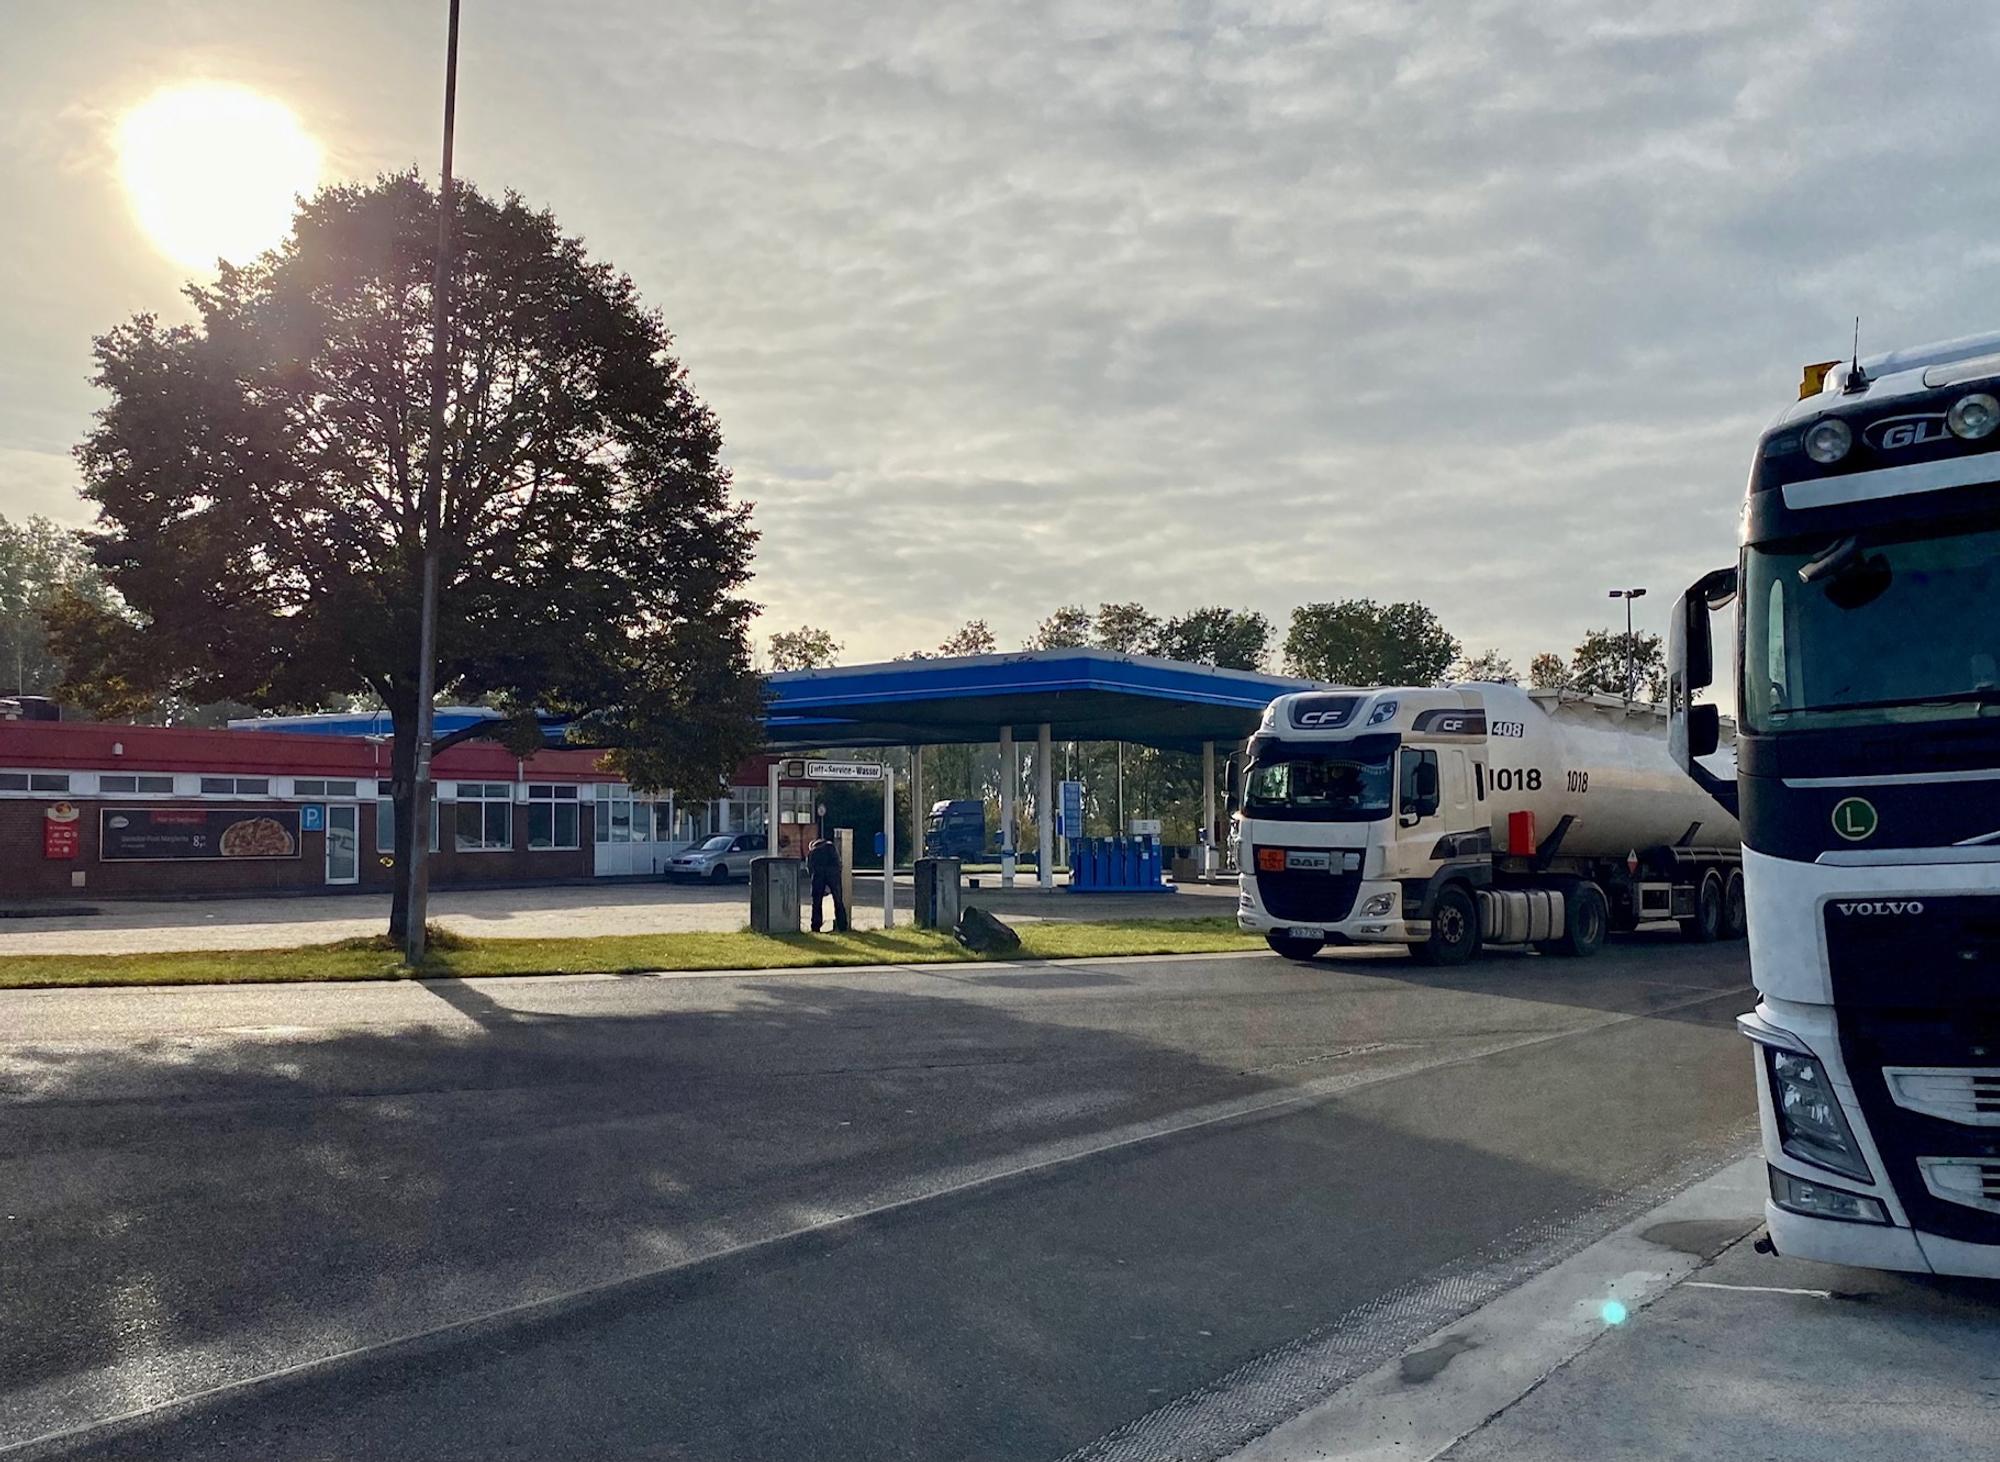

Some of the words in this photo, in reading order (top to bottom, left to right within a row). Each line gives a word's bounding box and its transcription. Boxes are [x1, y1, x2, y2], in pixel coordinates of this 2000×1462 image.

[1301, 711, 1342, 724] CF
[1443, 720, 1463, 731] CF
[1492, 722, 1523, 738] 408
[1489, 768, 1542, 791] 1018
[1567, 770, 1589, 793] 1018
[306, 808, 318, 828] P
[1846, 806, 1865, 832] L
[1289, 858, 1326, 867] DAF
[1836, 901, 1924, 916] VOLVO
